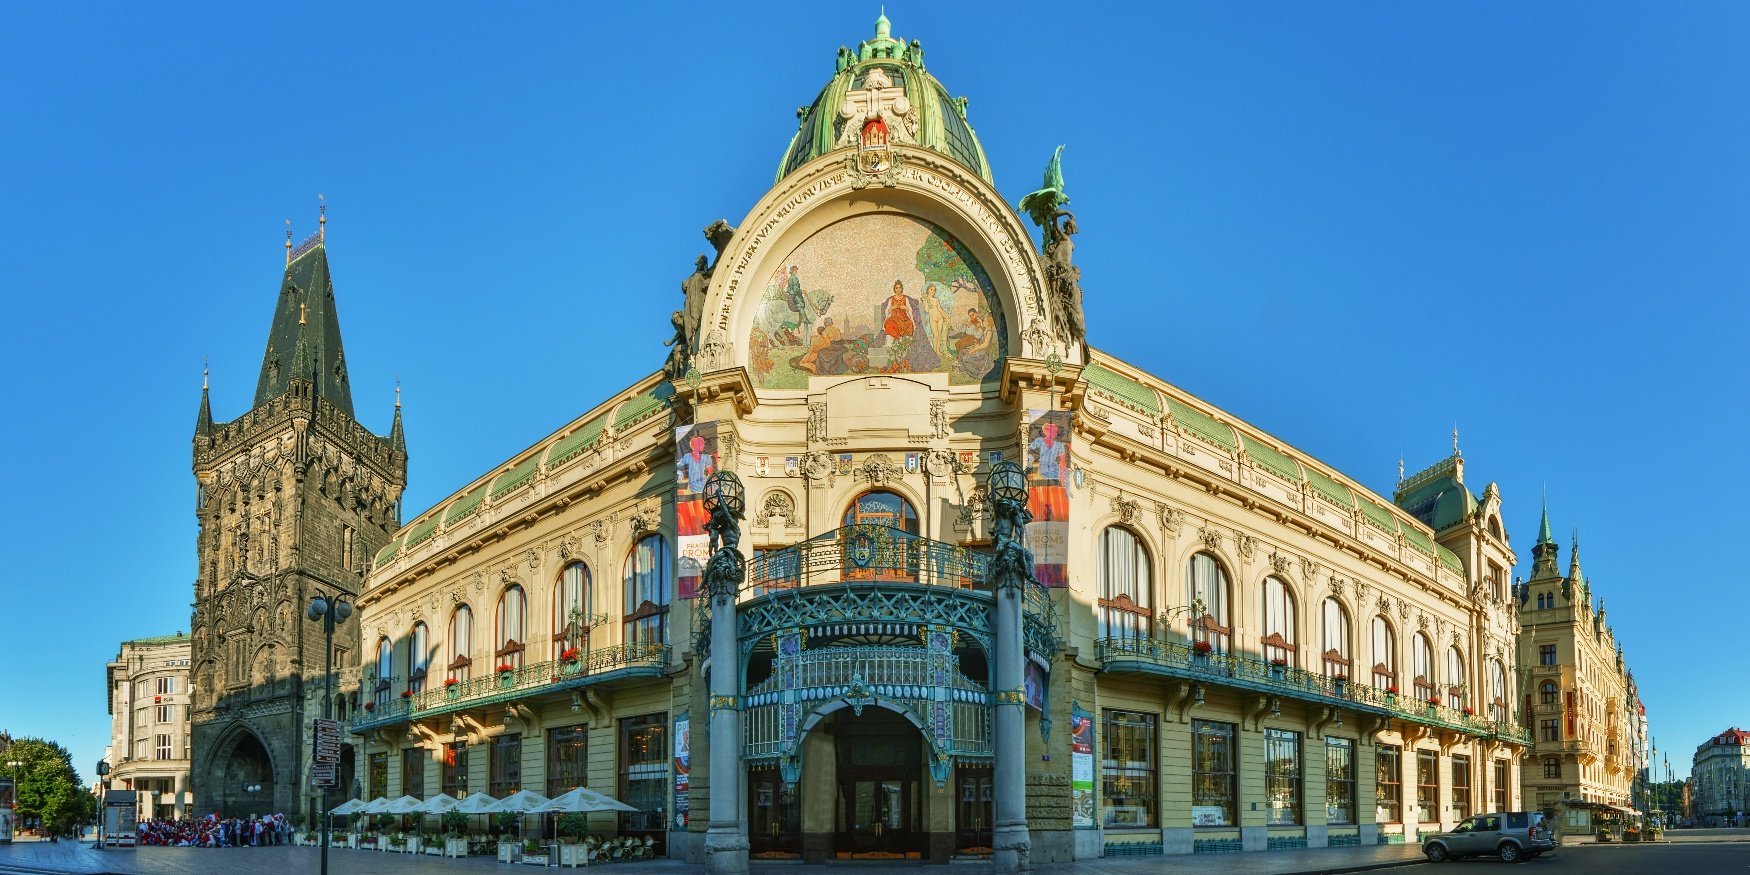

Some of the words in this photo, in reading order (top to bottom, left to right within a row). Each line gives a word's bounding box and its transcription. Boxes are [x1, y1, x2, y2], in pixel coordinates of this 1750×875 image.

[1029, 535, 1064, 545] PROMS
[687, 541, 709, 549] PRAGU
[682, 549, 710, 557] PROM
